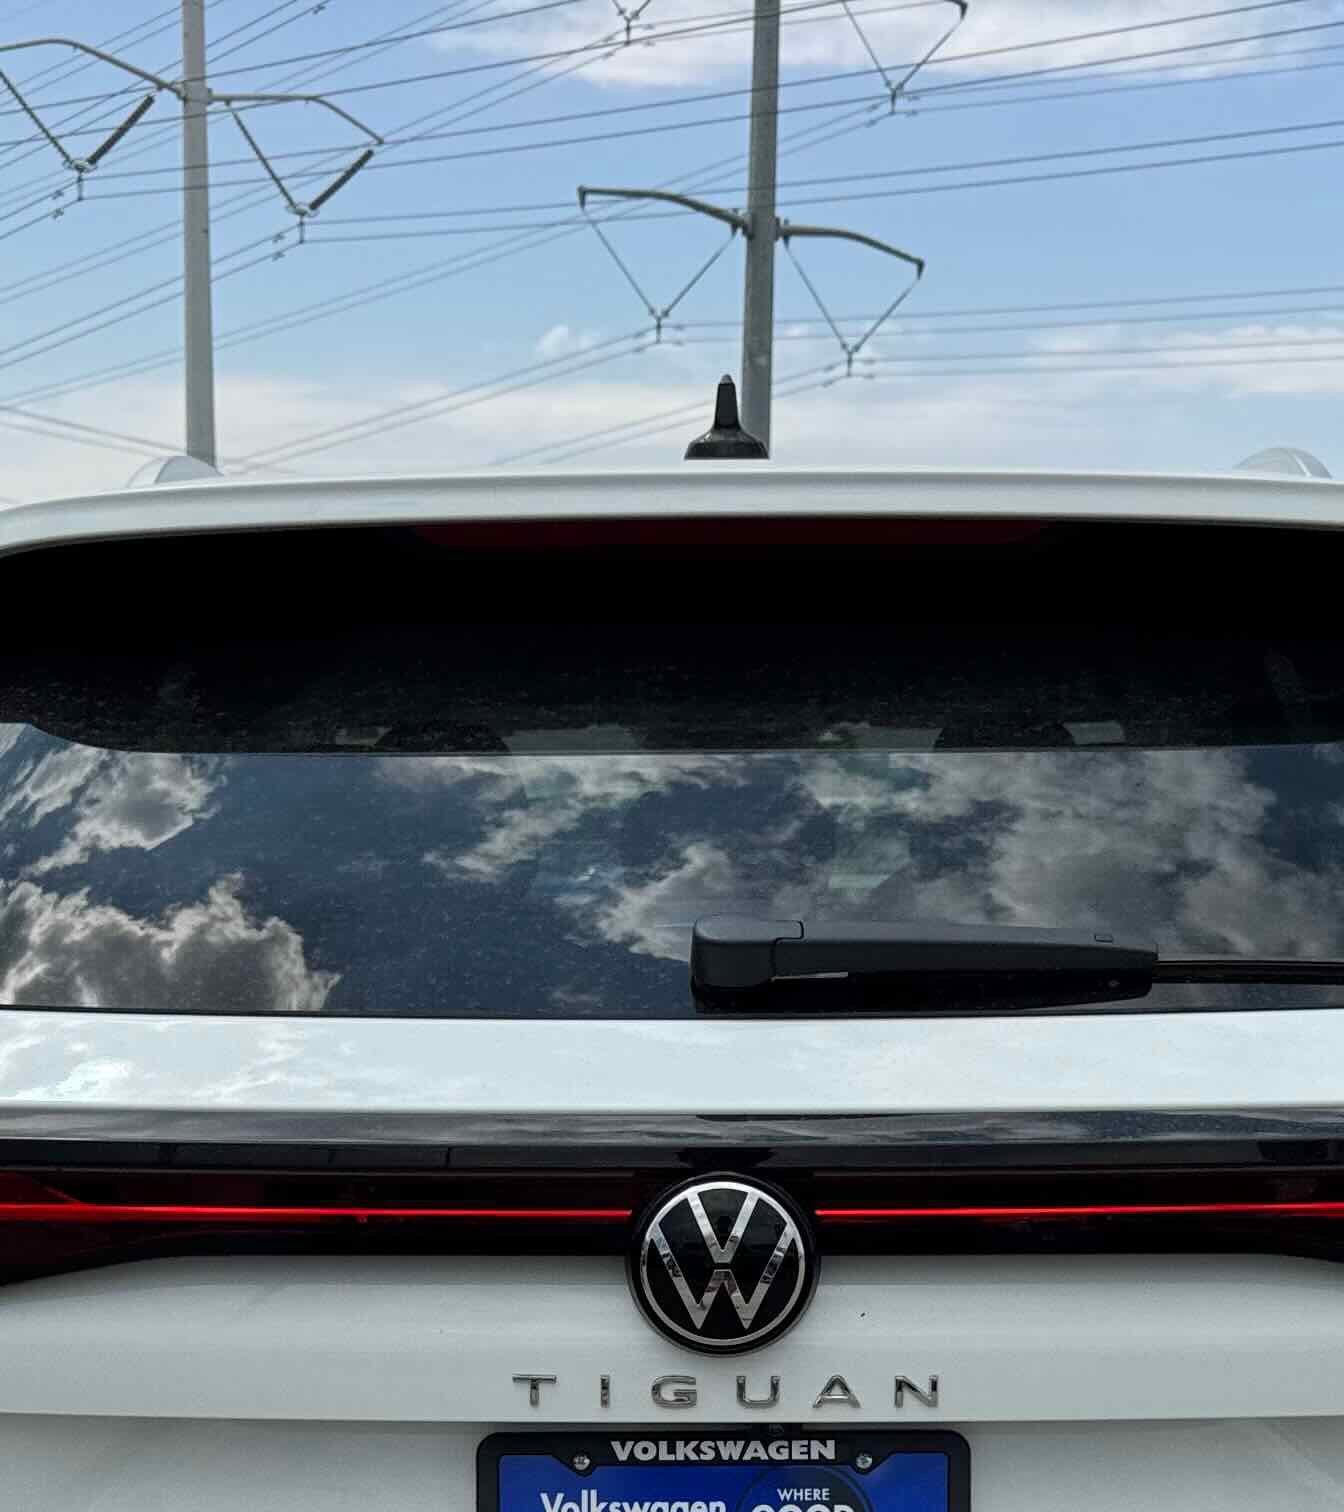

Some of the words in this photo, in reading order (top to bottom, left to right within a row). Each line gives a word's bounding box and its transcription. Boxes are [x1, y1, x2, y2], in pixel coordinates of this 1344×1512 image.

[512, 1373, 940, 1409] TIGUAN
[610, 1440, 836, 1462] VOLKSWAGEN
[776, 1488, 830, 1502] WHERE
